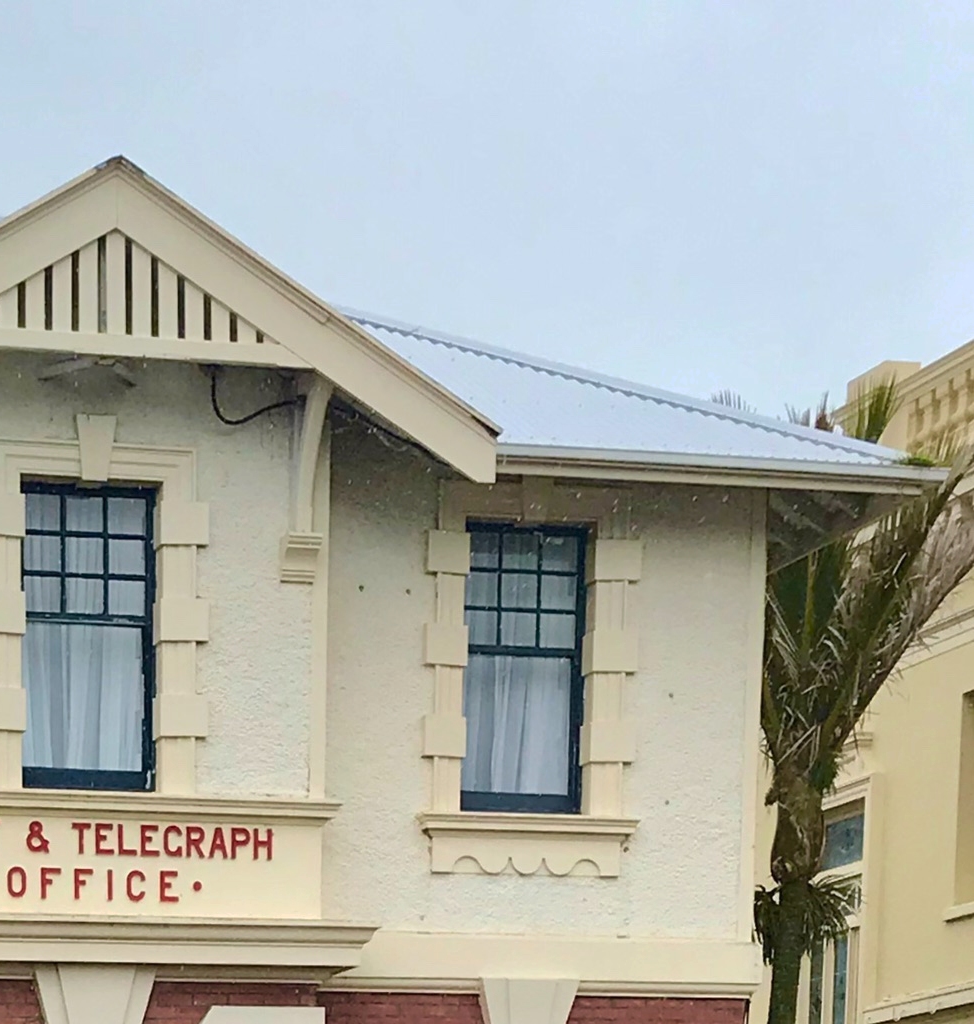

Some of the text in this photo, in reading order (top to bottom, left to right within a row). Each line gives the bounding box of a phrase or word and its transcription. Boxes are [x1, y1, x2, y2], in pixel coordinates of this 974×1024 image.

[26, 820, 51, 854] &
[71, 821, 275, 860] TELEGRAPH
[6, 865, 180, 903] OFFICE
